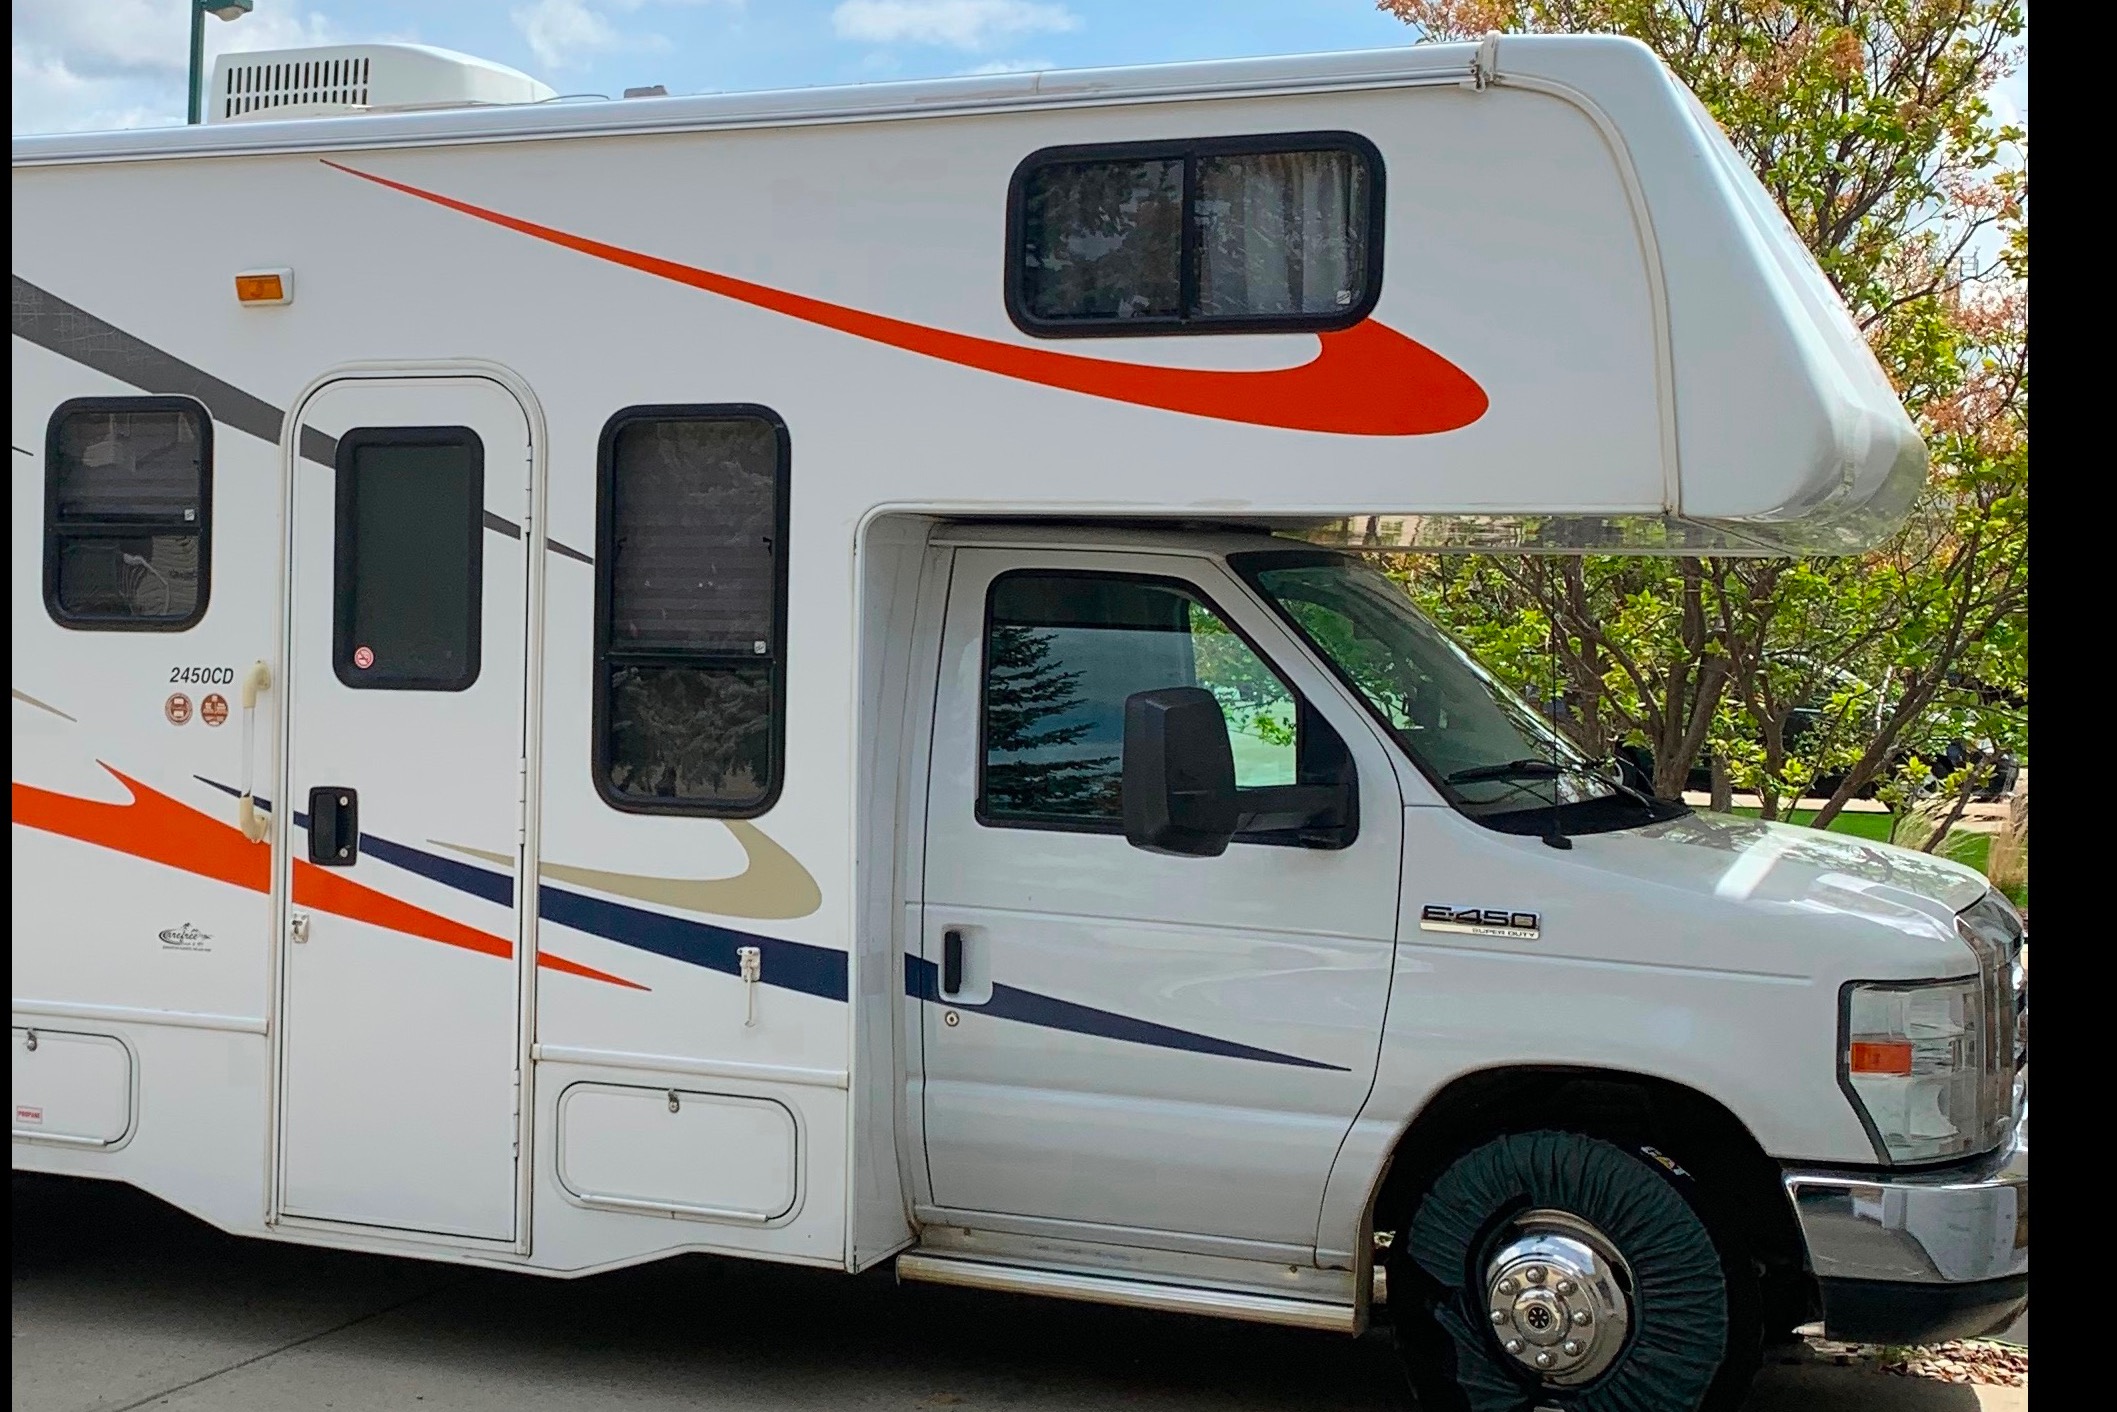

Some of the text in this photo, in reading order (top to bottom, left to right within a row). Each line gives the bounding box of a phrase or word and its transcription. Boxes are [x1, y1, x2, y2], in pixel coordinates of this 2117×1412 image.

[169, 666, 234, 685] 2450CD
[1421, 905, 1537, 930] E-450
[1472, 927, 1535, 938] SUPER DUTY
